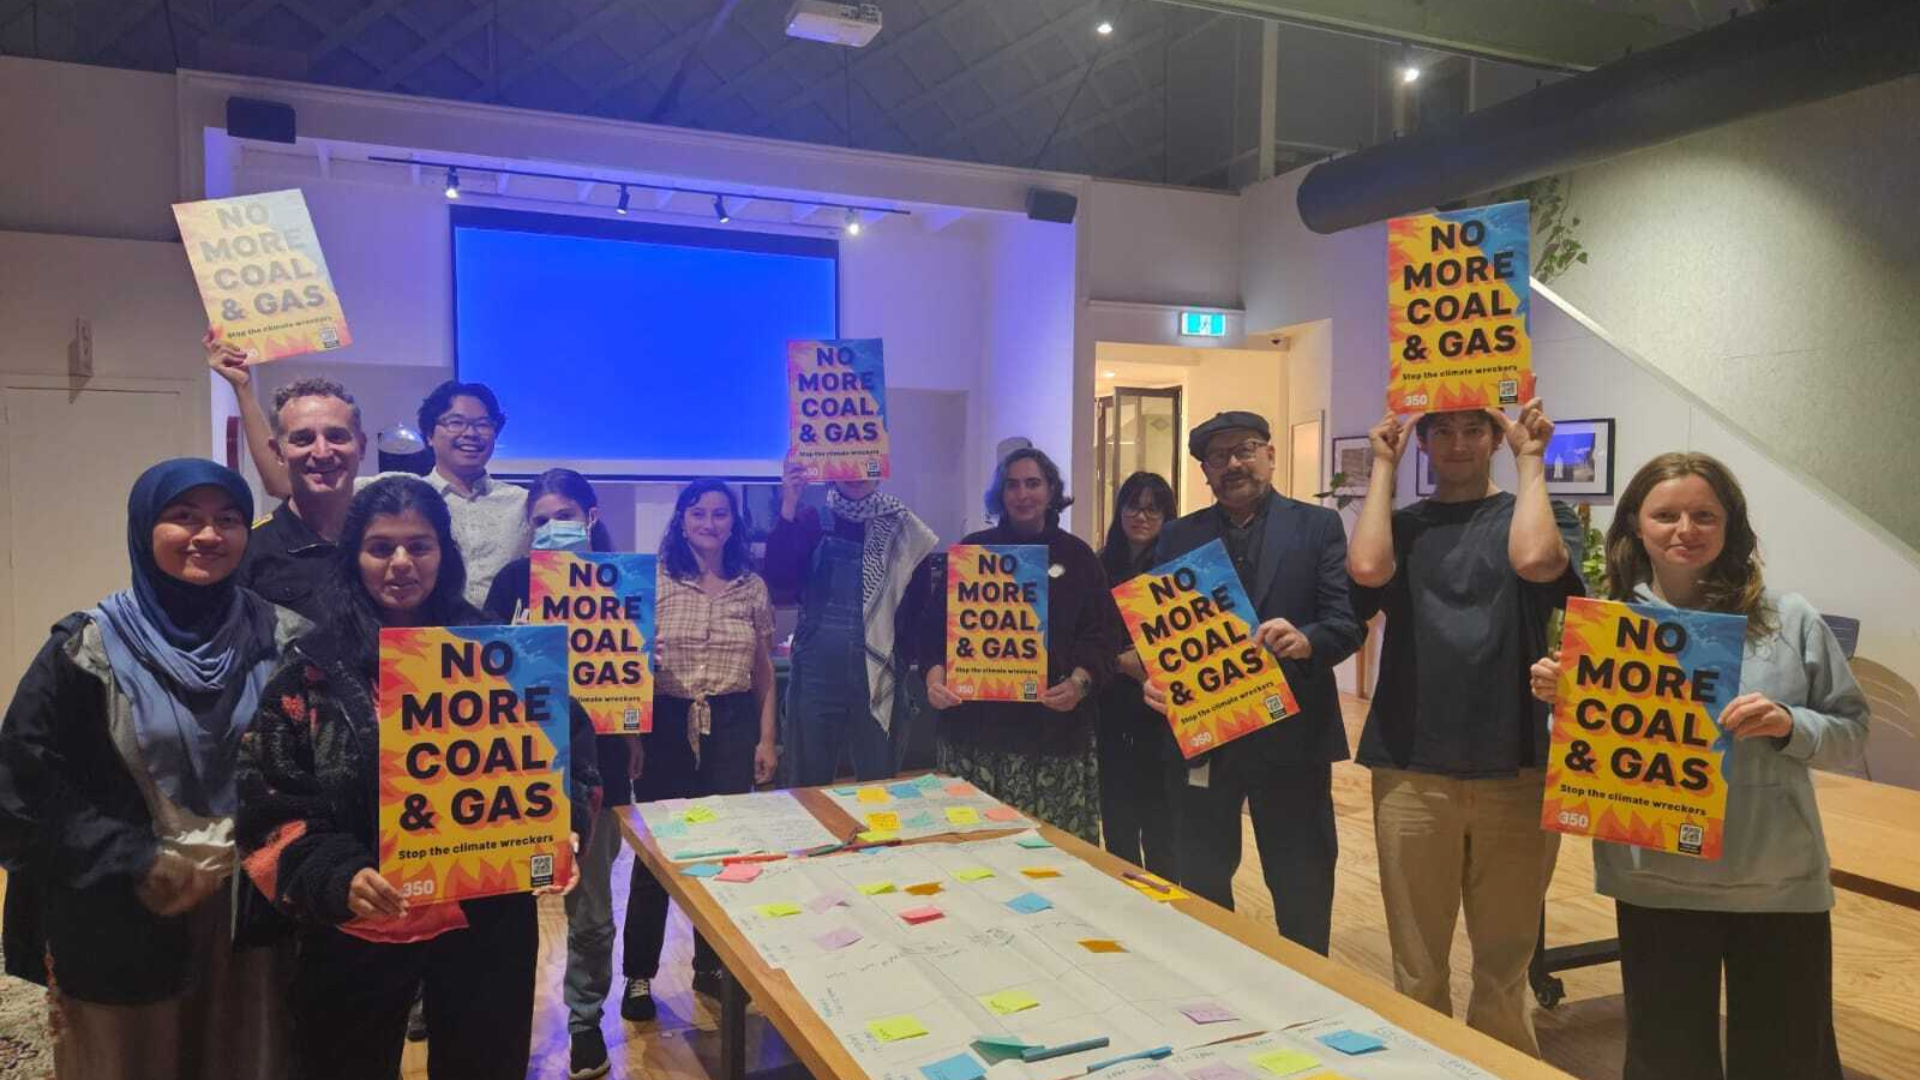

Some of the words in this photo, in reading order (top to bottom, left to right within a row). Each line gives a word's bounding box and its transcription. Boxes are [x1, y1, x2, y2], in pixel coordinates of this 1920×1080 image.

[216, 203, 269, 229] NO
[200, 228, 306, 262] MORE
[1431, 220, 1485, 252] NO
[214, 258, 312, 290] COAL
[1404, 251, 1515, 291] MORE
[221, 298, 246, 321] &
[253, 285, 326, 315] GAS
[1407, 290, 1512, 325] COAL
[816, 347, 854, 366] NO
[1403, 334, 1427, 361] &
[1439, 325, 1516, 357] GAS
[798, 371, 874, 391] MORE
[1402, 373, 1421, 381] Stop
[1424, 371, 1438, 379] the
[1440, 367, 1473, 377] climate
[1475, 365, 1518, 374] wreckers
[801, 397, 874, 417] COAL
[799, 423, 816, 442] &
[825, 422, 878, 441] GAS
[569, 563, 618, 588] NO
[979, 554, 1017, 574] NO
[958, 581, 1037, 603] MORE
[1149, 567, 1196, 605] NO
[543, 595, 642, 620] MORE
[960, 609, 1034, 631] COAL
[1140, 584, 1235, 645] MORE
[571, 628, 638, 653] OAL
[956, 637, 974, 658] &
[982, 637, 1037, 659] GAS
[1158, 621, 1247, 673] COAL
[1616, 616, 1687, 654] NO
[441, 640, 514, 679] NO
[573, 660, 641, 686] GAS
[1169, 680, 1194, 706] &
[1197, 649, 1264, 692] GAS
[1576, 655, 1719, 704] MORE
[401, 687, 552, 730] MORE
[1576, 698, 1707, 747] COAL
[406, 735, 547, 779] COAL
[1565, 740, 1596, 774] &
[1610, 747, 1709, 791] GAS
[400, 793, 435, 831] &
[451, 781, 553, 825] GAS
[1560, 784, 1584, 797] Stop
[1587, 787, 1605, 799] the
[1608, 792, 1650, 806] climate
[1652, 800, 1706, 816] wreckers
[398, 850, 427, 860] Stop
[430, 847, 450, 857] the
[452, 839, 497, 854] climate
[500, 834, 554, 848] wreckers
[402, 879, 434, 897] 350
